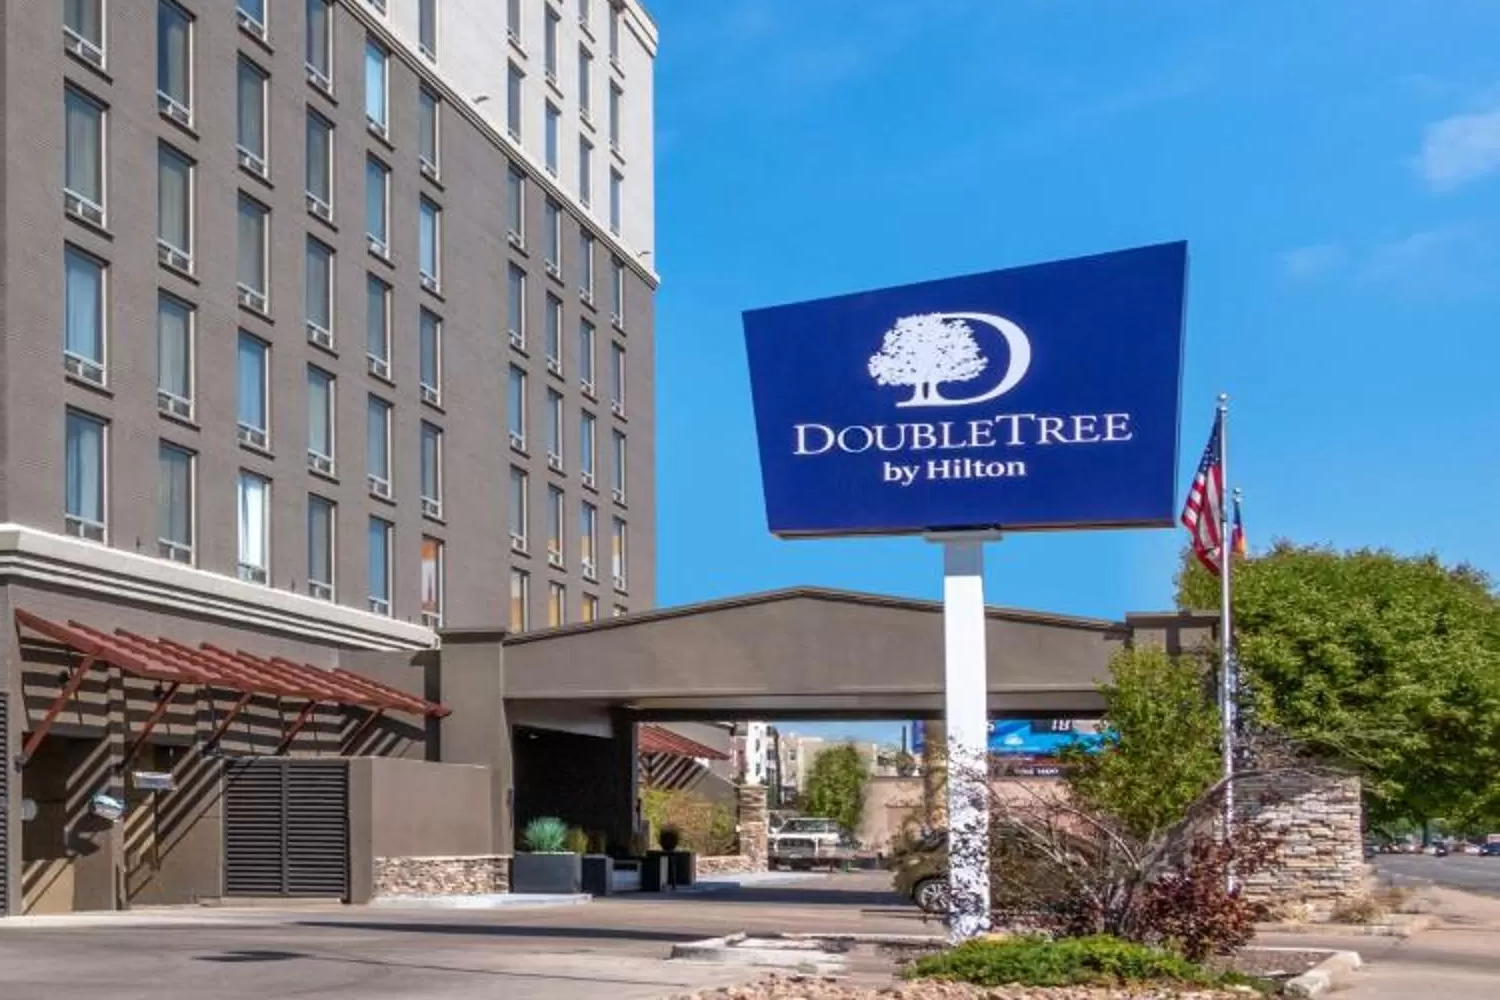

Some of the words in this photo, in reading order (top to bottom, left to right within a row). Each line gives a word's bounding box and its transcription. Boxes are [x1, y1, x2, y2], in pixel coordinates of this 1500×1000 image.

[793, 413, 1133, 455] DOUBLETREE
[883, 461, 921, 486] by
[927, 458, 1026, 480] Hilton
